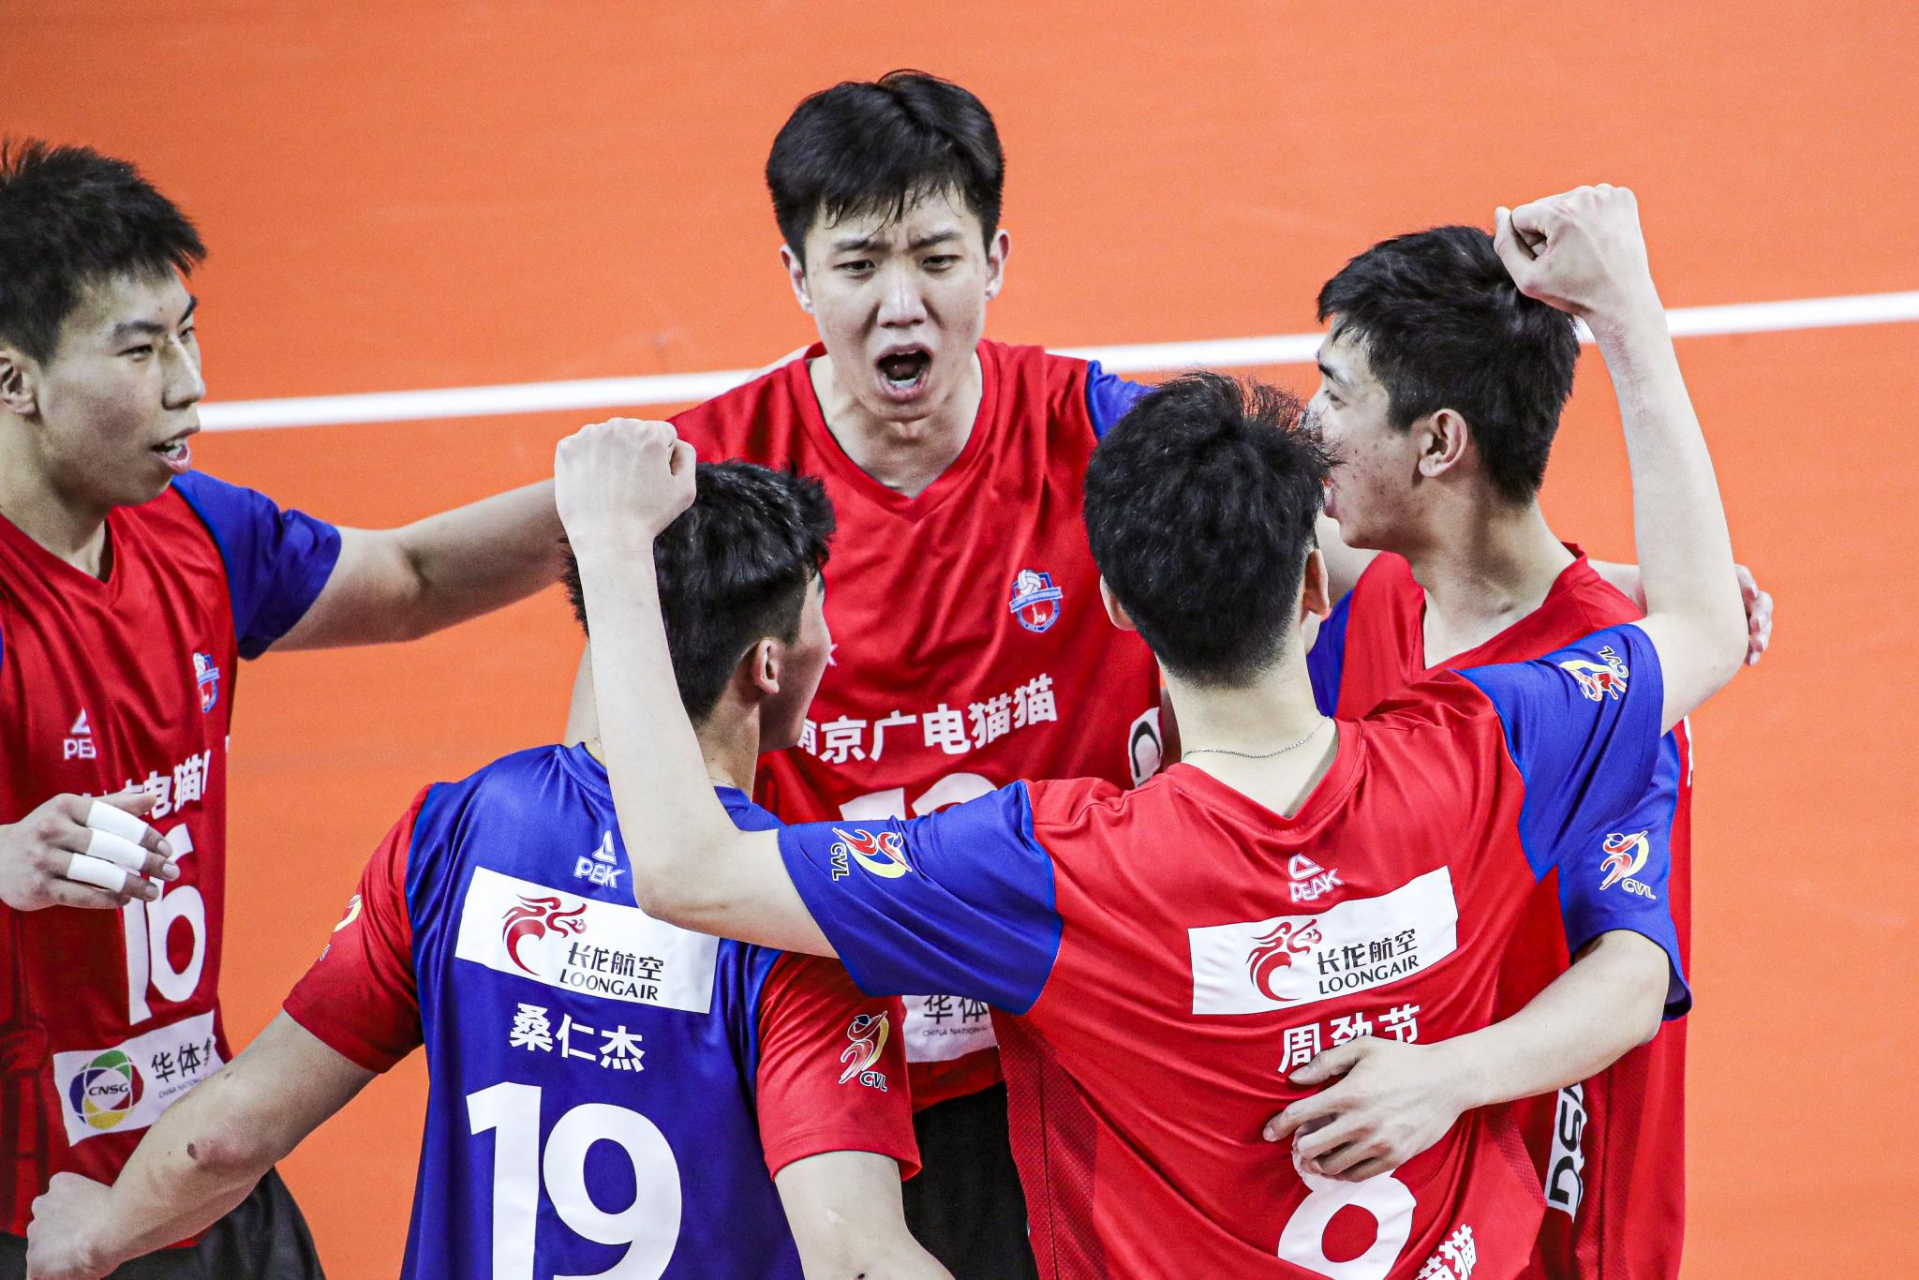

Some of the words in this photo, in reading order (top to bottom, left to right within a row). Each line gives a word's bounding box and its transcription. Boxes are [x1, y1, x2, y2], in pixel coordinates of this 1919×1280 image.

[1597, 646, 1629, 679] CVL
[573, 855, 626, 889] PEK
[831, 841, 848, 881] CVL
[1288, 868, 1344, 903] PEAK
[1622, 878, 1656, 900] CVL
[568, 941, 664, 982] 长龙航空
[1317, 928, 1418, 976] 长龙航空
[559, 970, 659, 1002] LOONGAIR
[1319, 955, 1420, 995] LOONGAIR
[509, 1003, 646, 1073] 桑仁杰
[923, 1028, 947, 1037] CHINA
[89, 1083, 129, 1096] CNSG
[859, 1071, 888, 1092] CVL
[466, 1081, 682, 1280] 19
